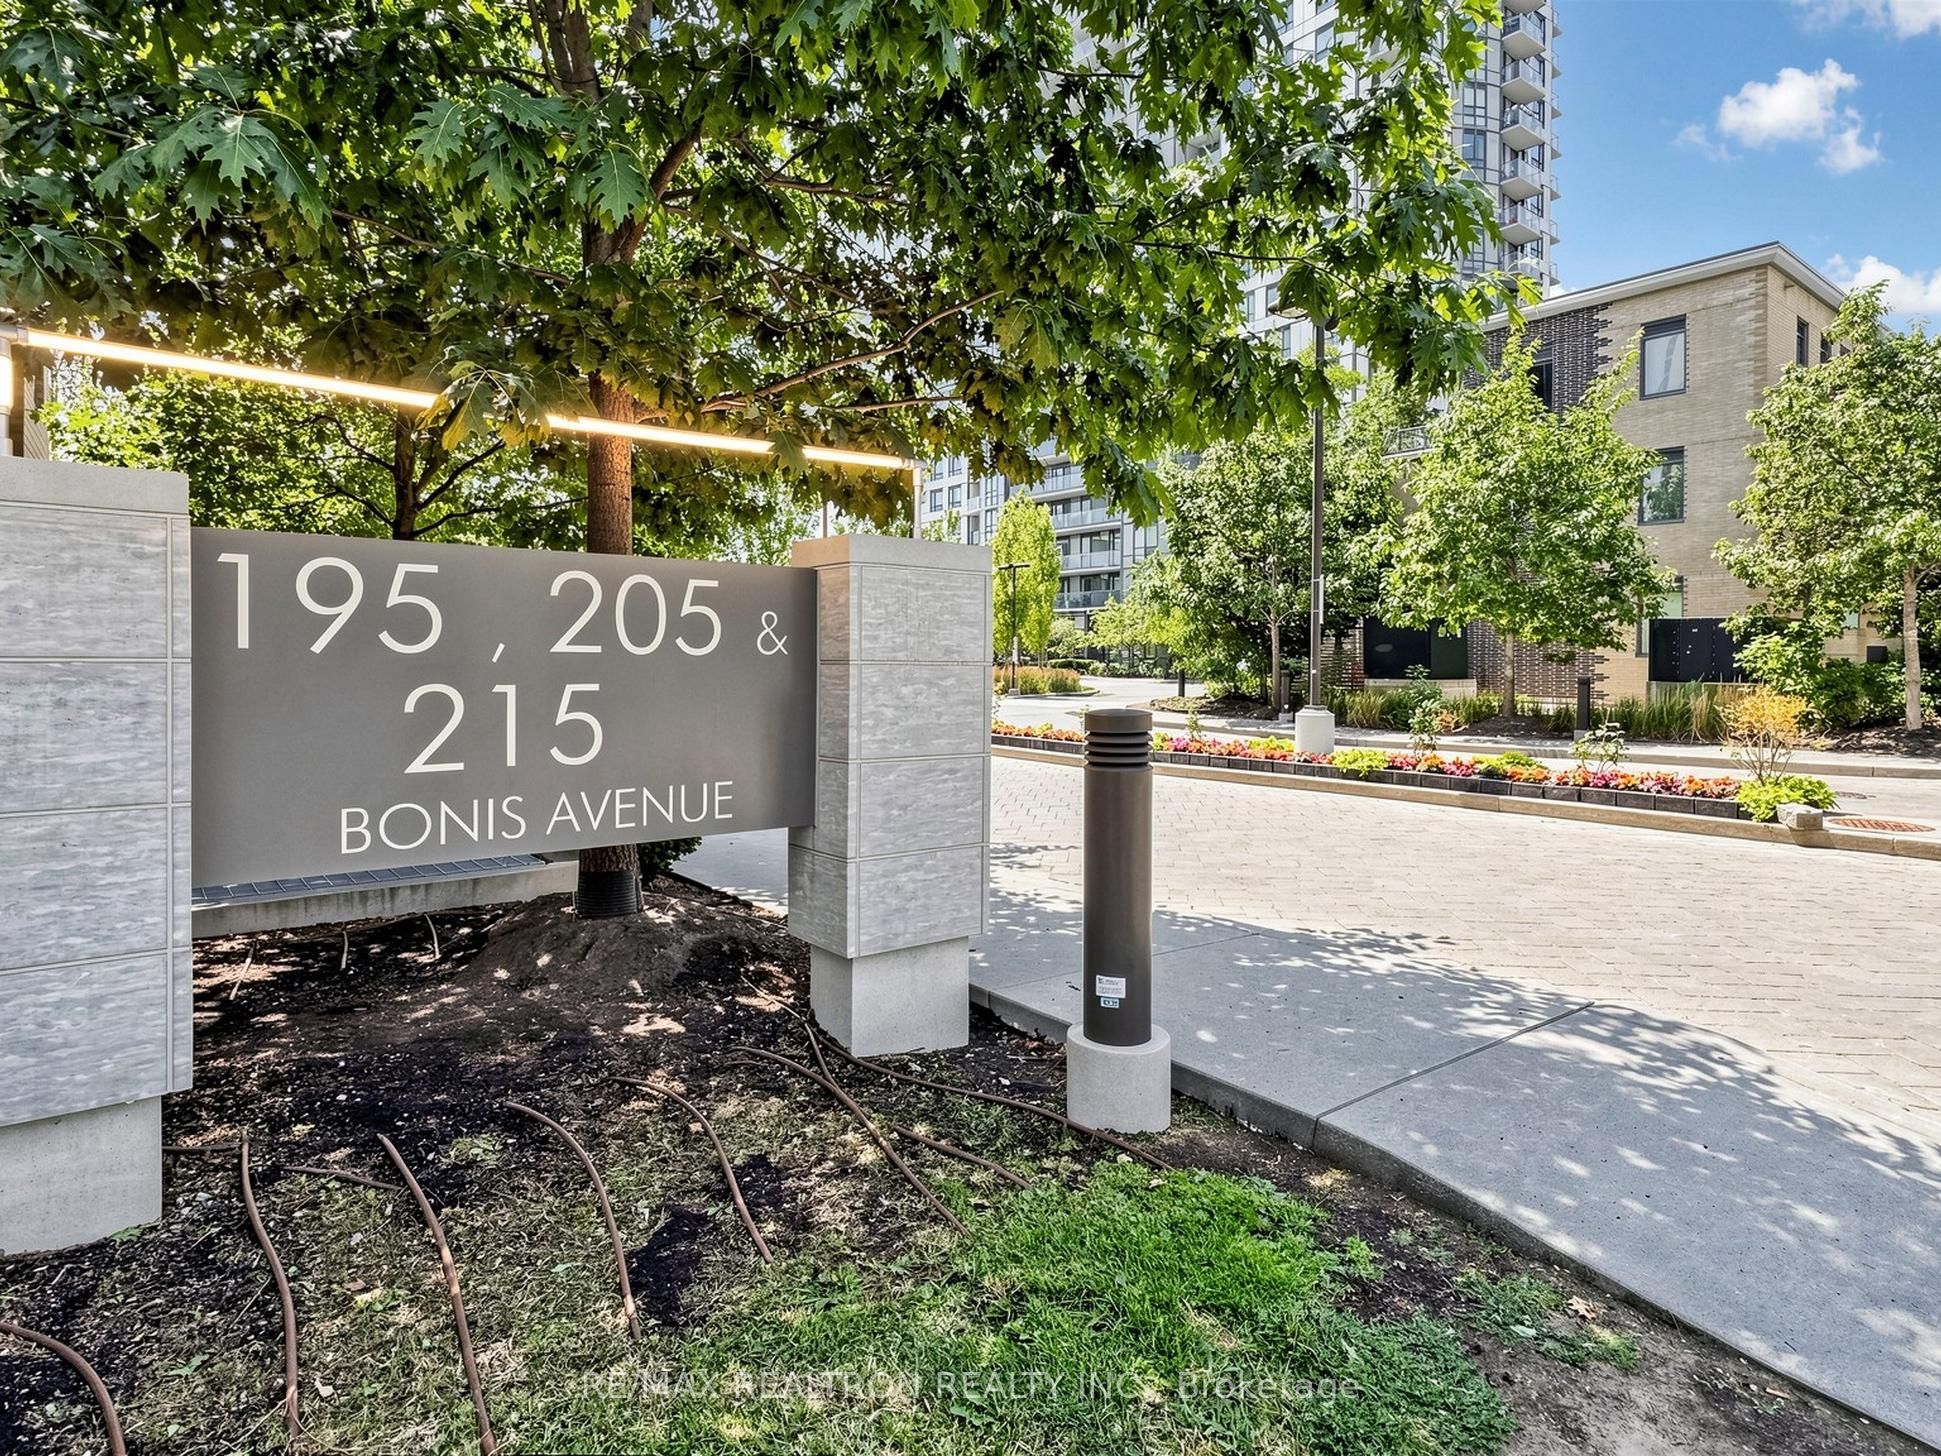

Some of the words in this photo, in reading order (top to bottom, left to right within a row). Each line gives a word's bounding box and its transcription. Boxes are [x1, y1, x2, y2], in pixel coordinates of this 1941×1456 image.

[217, 553, 443, 655] 195
[549, 570, 722, 657] 205
[756, 610, 789, 656] &
[404, 682, 603, 774] 215
[340, 795, 527, 855] BONIS
[546, 780, 734, 836] AVENUE
